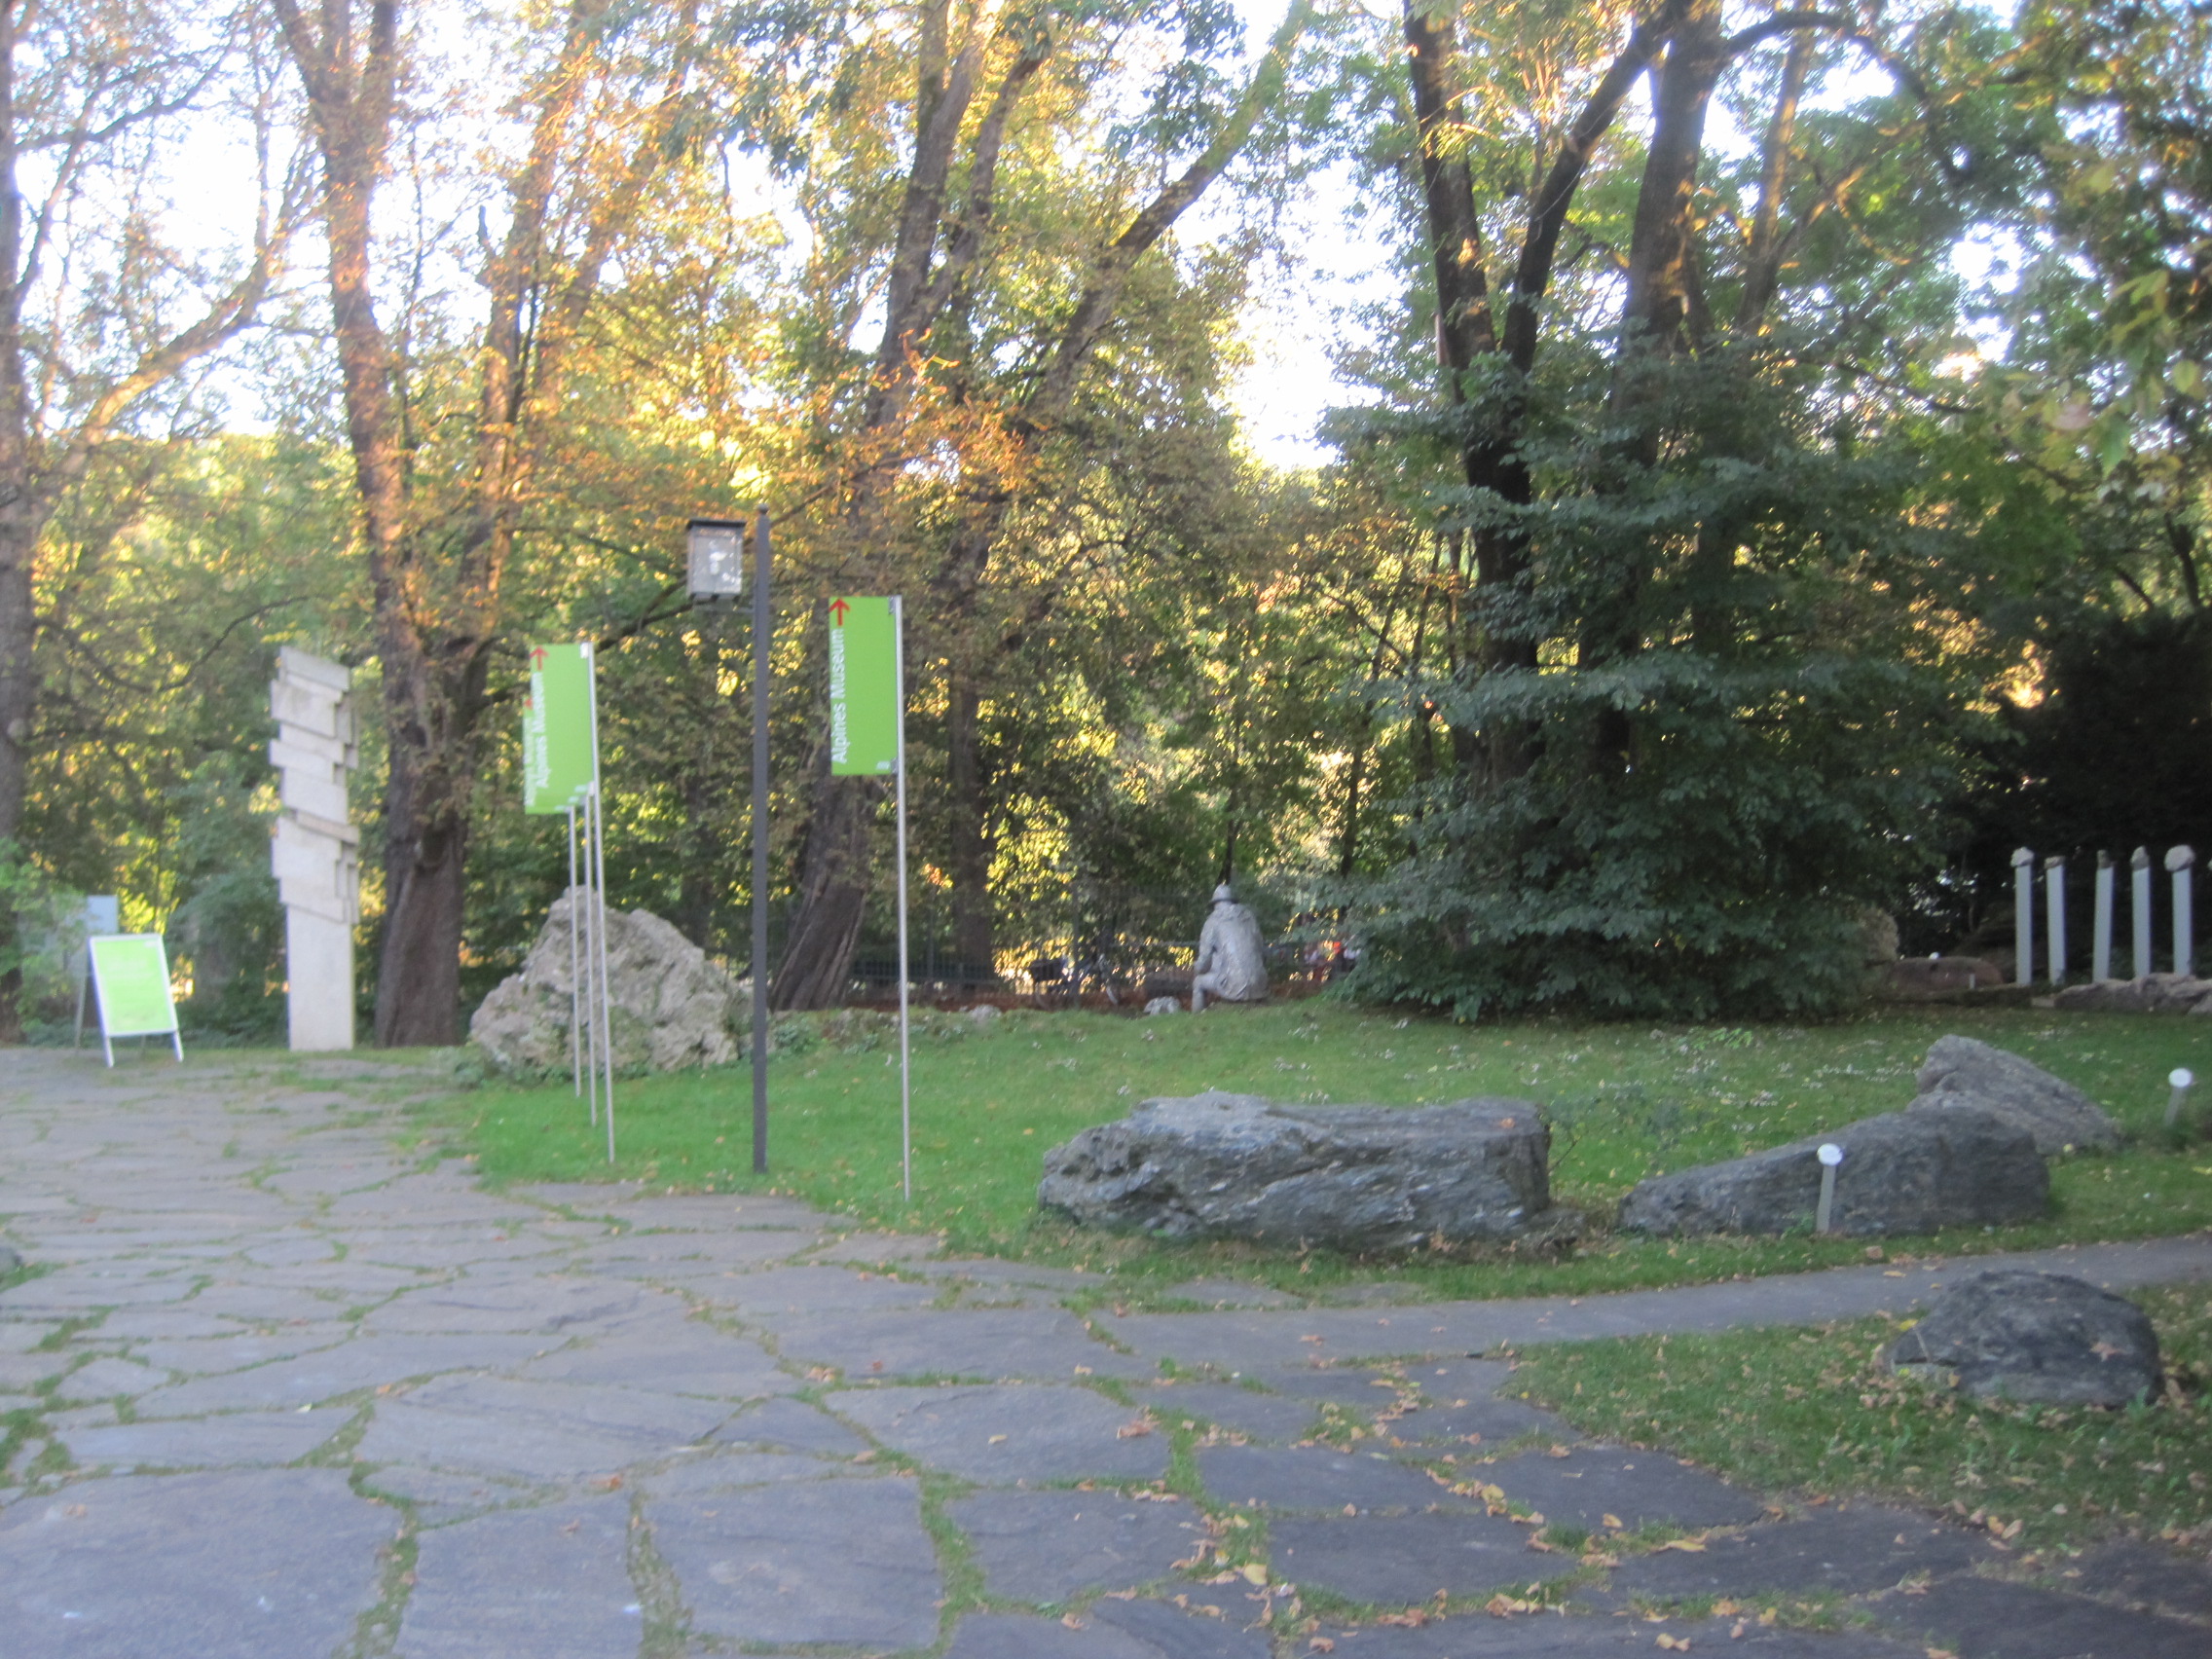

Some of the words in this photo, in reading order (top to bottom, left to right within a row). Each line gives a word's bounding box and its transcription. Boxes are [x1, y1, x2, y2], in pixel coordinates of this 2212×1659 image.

[830, 628, 844, 699] Museum
[533, 672, 545, 734] Museum
[830, 703, 850, 763] Alpines
